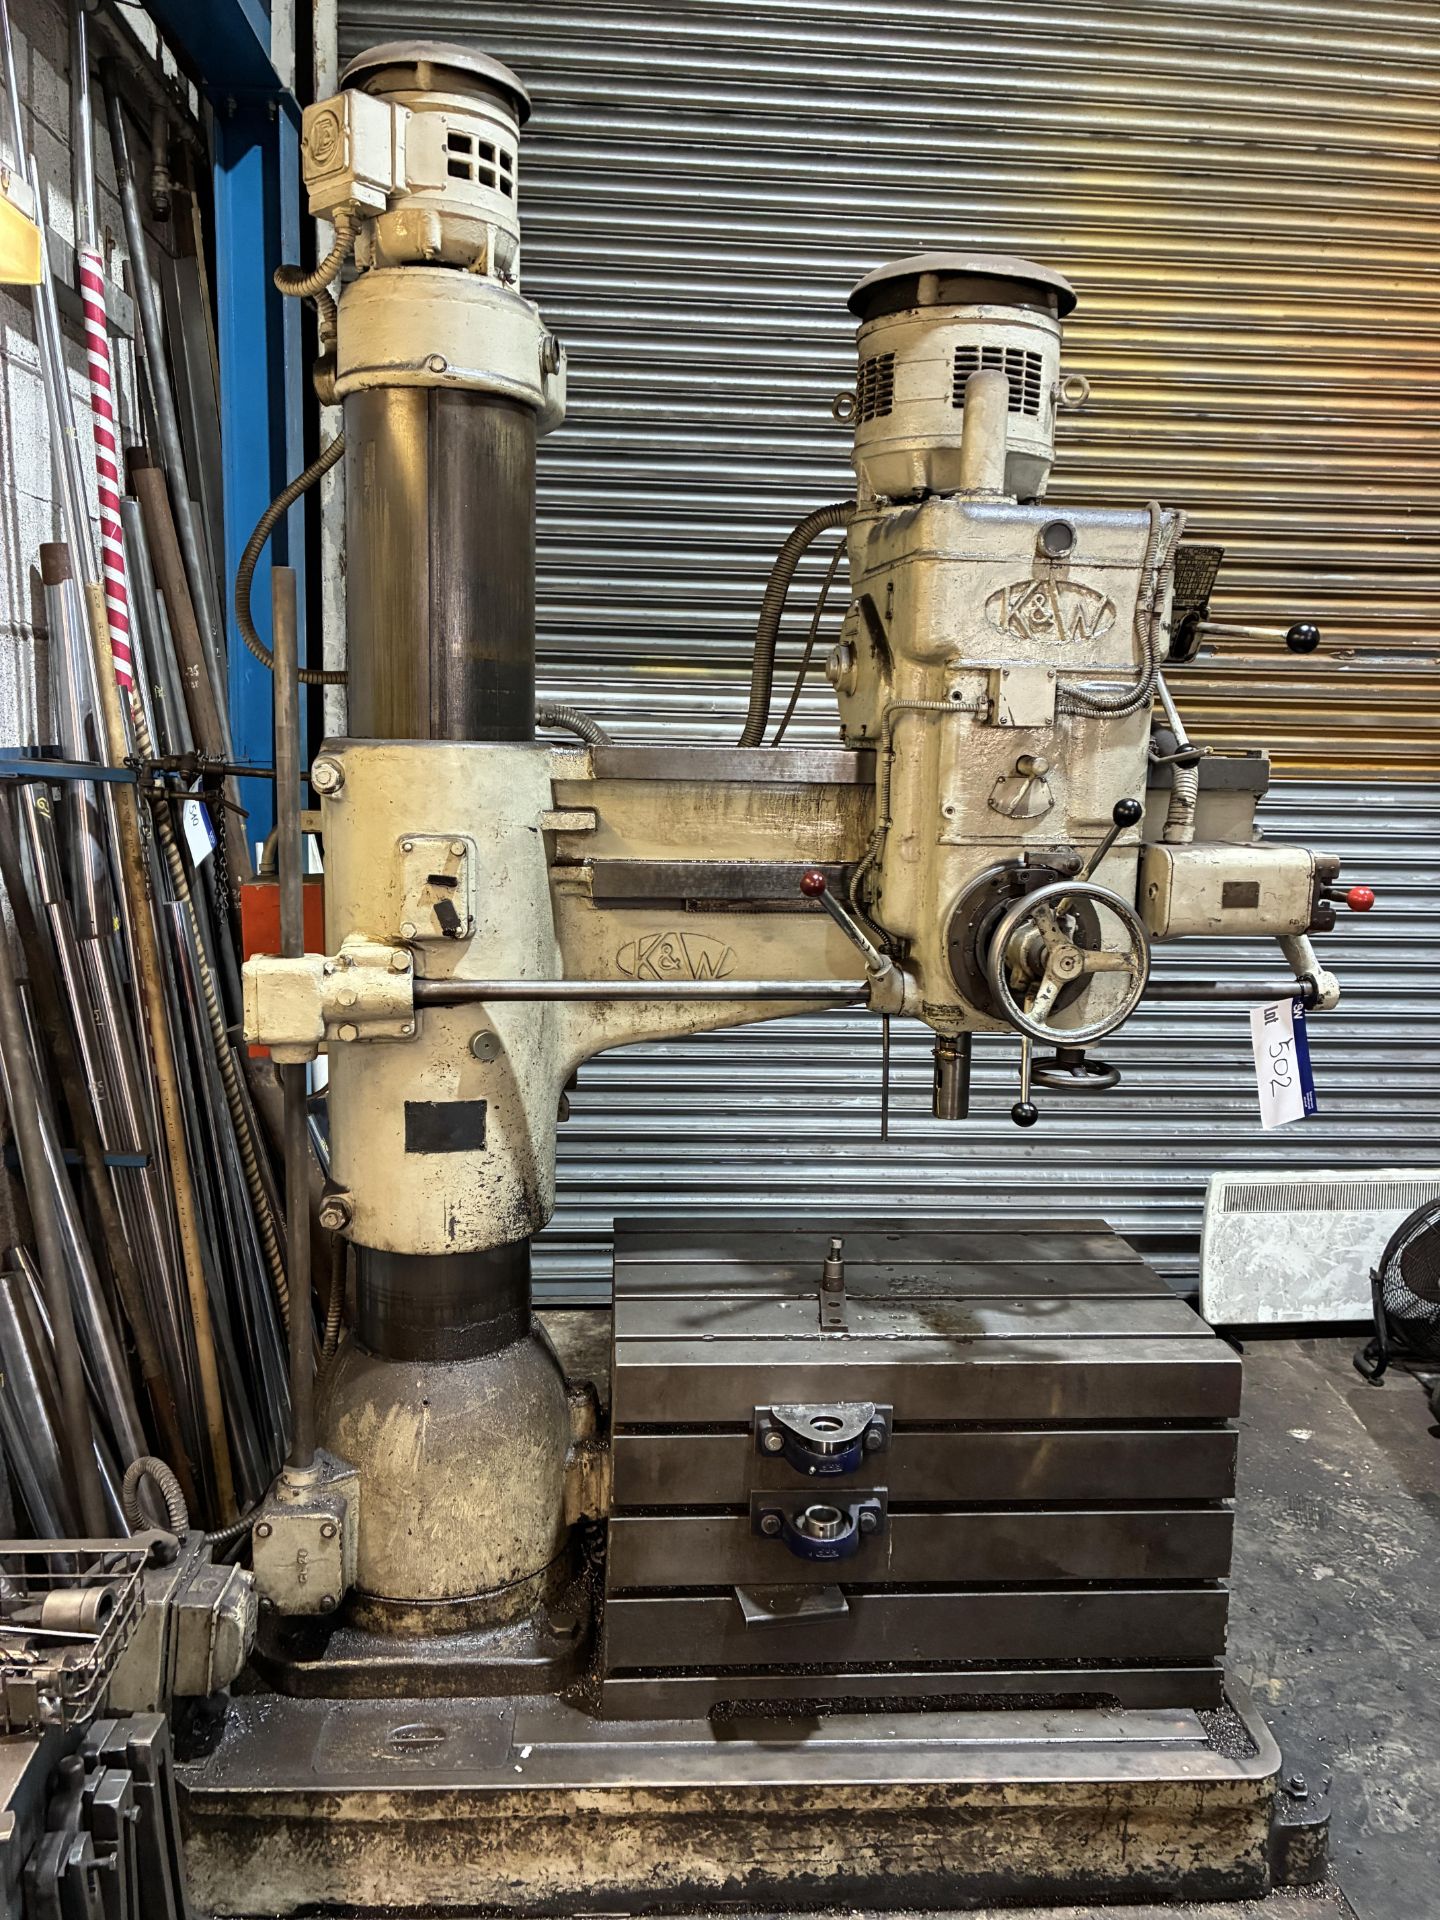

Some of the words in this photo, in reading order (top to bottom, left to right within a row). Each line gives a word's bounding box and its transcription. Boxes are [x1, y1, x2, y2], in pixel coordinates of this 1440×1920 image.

[999, 579, 1109, 642] K&W
[633, 931, 731, 981] K&W
[1264, 1005, 1279, 1026] Lot
[1269, 1038, 1294, 1098] 502
